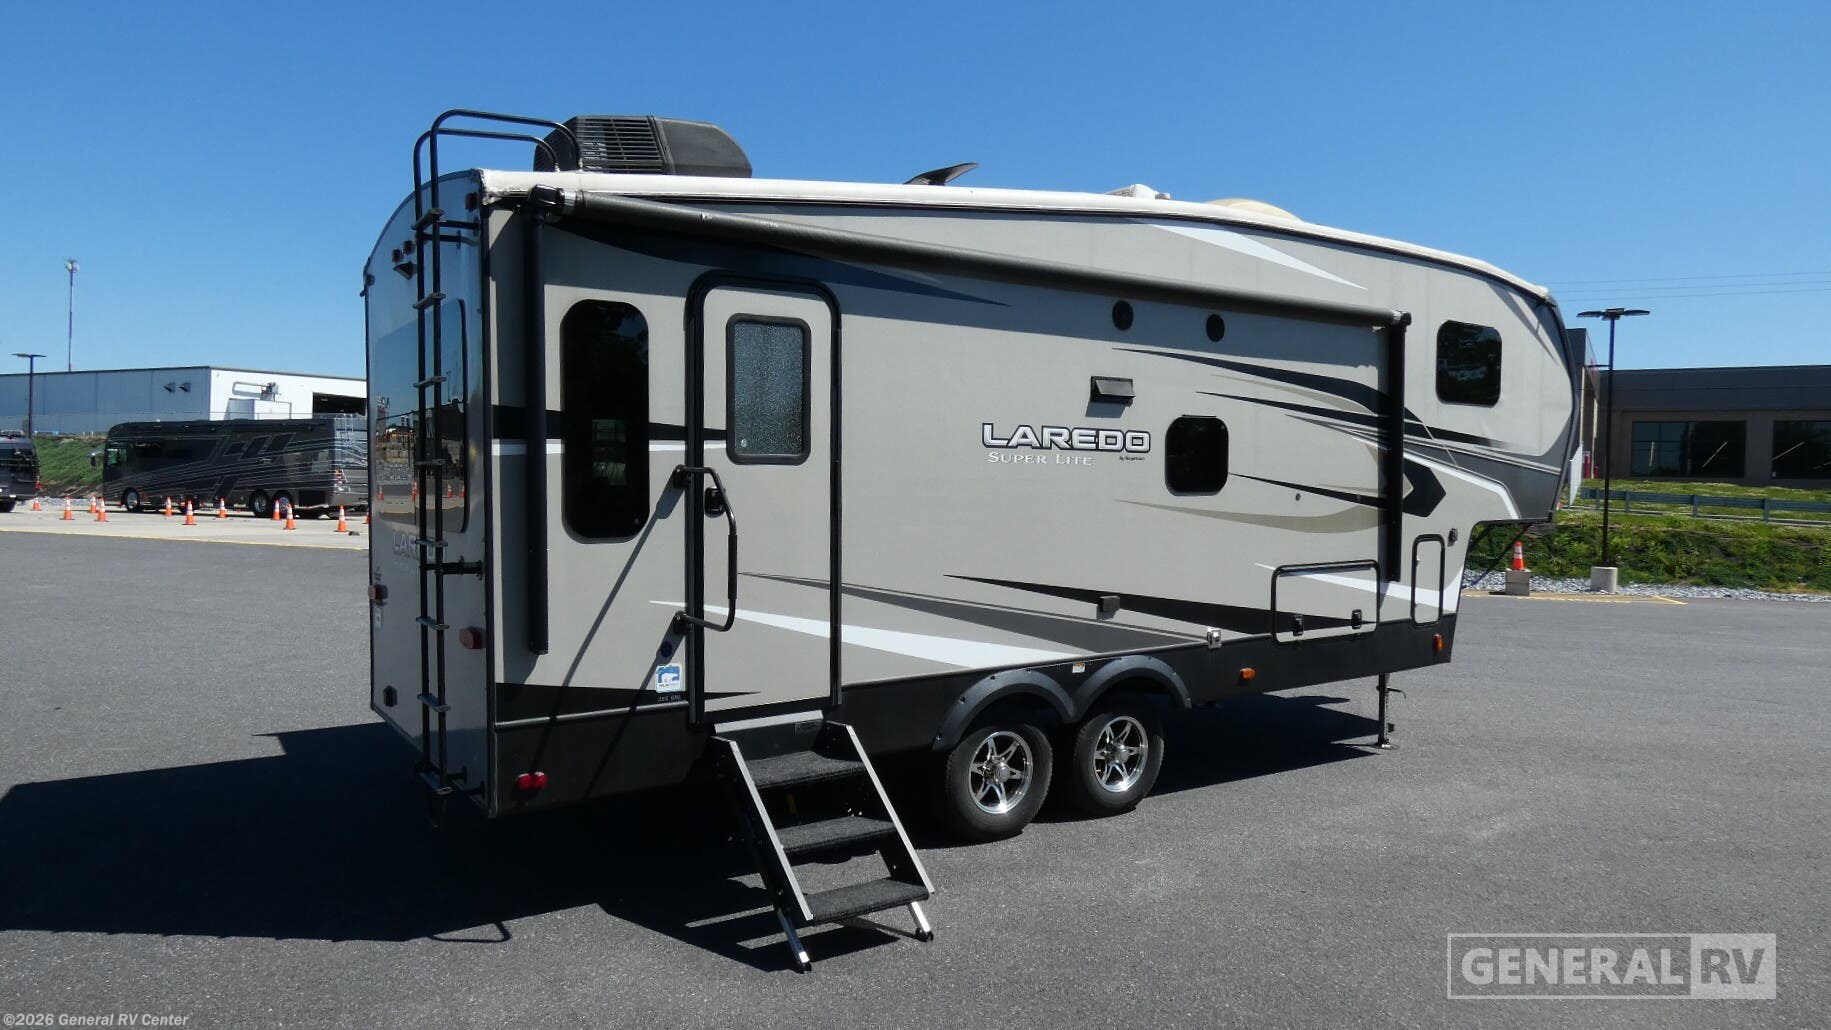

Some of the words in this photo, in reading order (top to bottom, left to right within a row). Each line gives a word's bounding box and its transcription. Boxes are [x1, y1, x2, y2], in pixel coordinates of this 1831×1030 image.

[982, 422, 1152, 454] LAREDO
[987, 451, 1048, 464] SUPER
[1056, 452, 1094, 467] LITE
